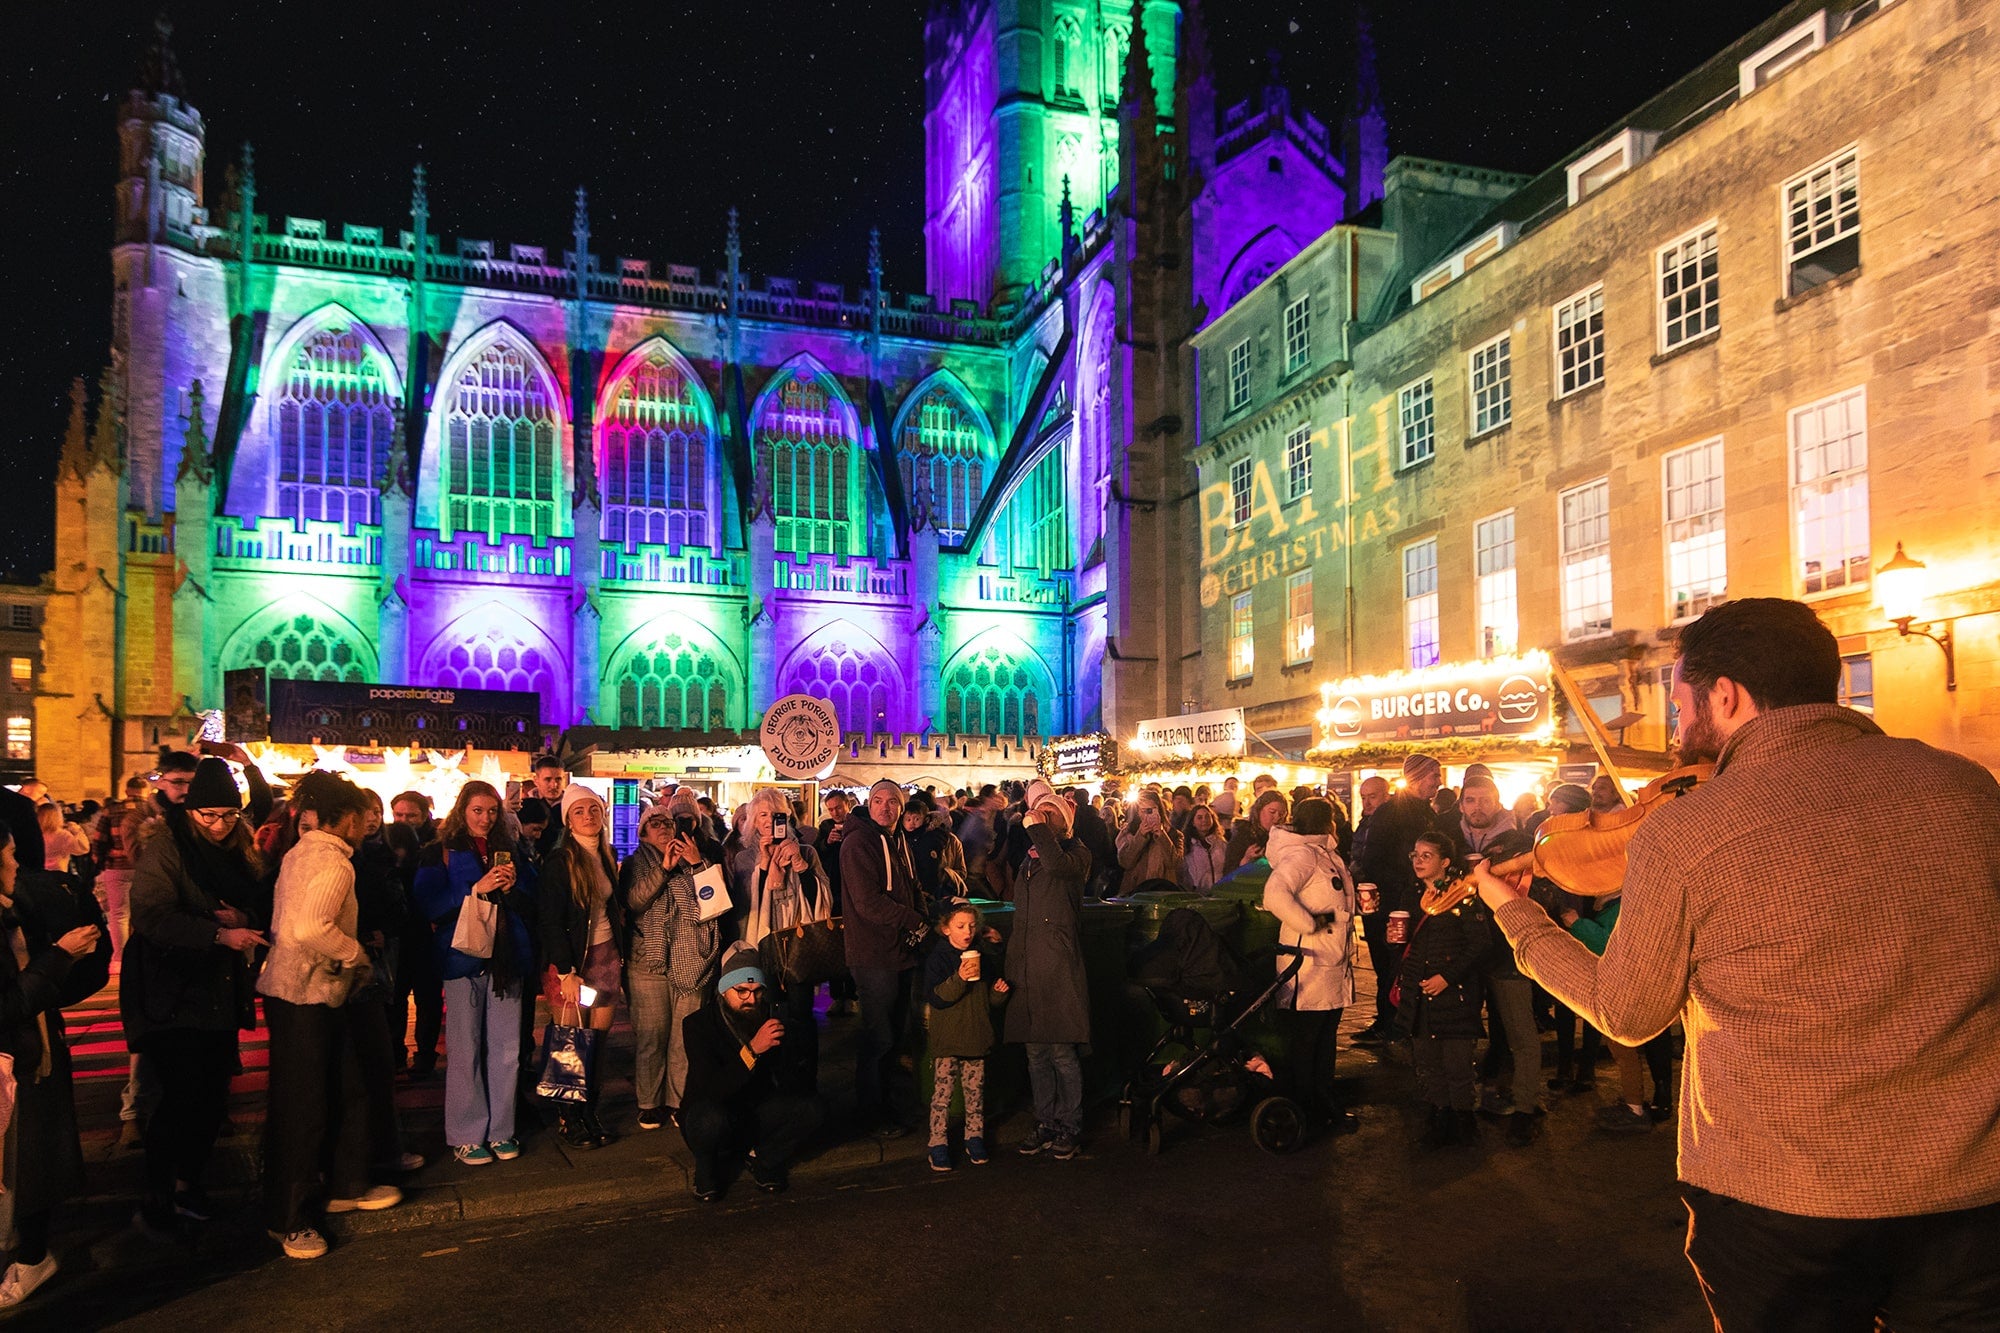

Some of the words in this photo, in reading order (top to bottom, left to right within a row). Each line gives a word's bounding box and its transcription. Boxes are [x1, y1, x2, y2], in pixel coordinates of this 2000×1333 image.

[1199, 394, 1397, 567] BATH
[1223, 497, 1400, 596] CHRISTMAS
[369, 688, 455, 703] paperstarlights
[1371, 691, 1451, 720] BURGER
[1455, 687, 1490, 712] Co.
[766, 699, 797, 735] GEORGIE
[800, 700, 834, 736] PORGIE'S
[1197, 721, 1237, 743] CHEESE
[770, 745, 832, 770] PUDDINGS
